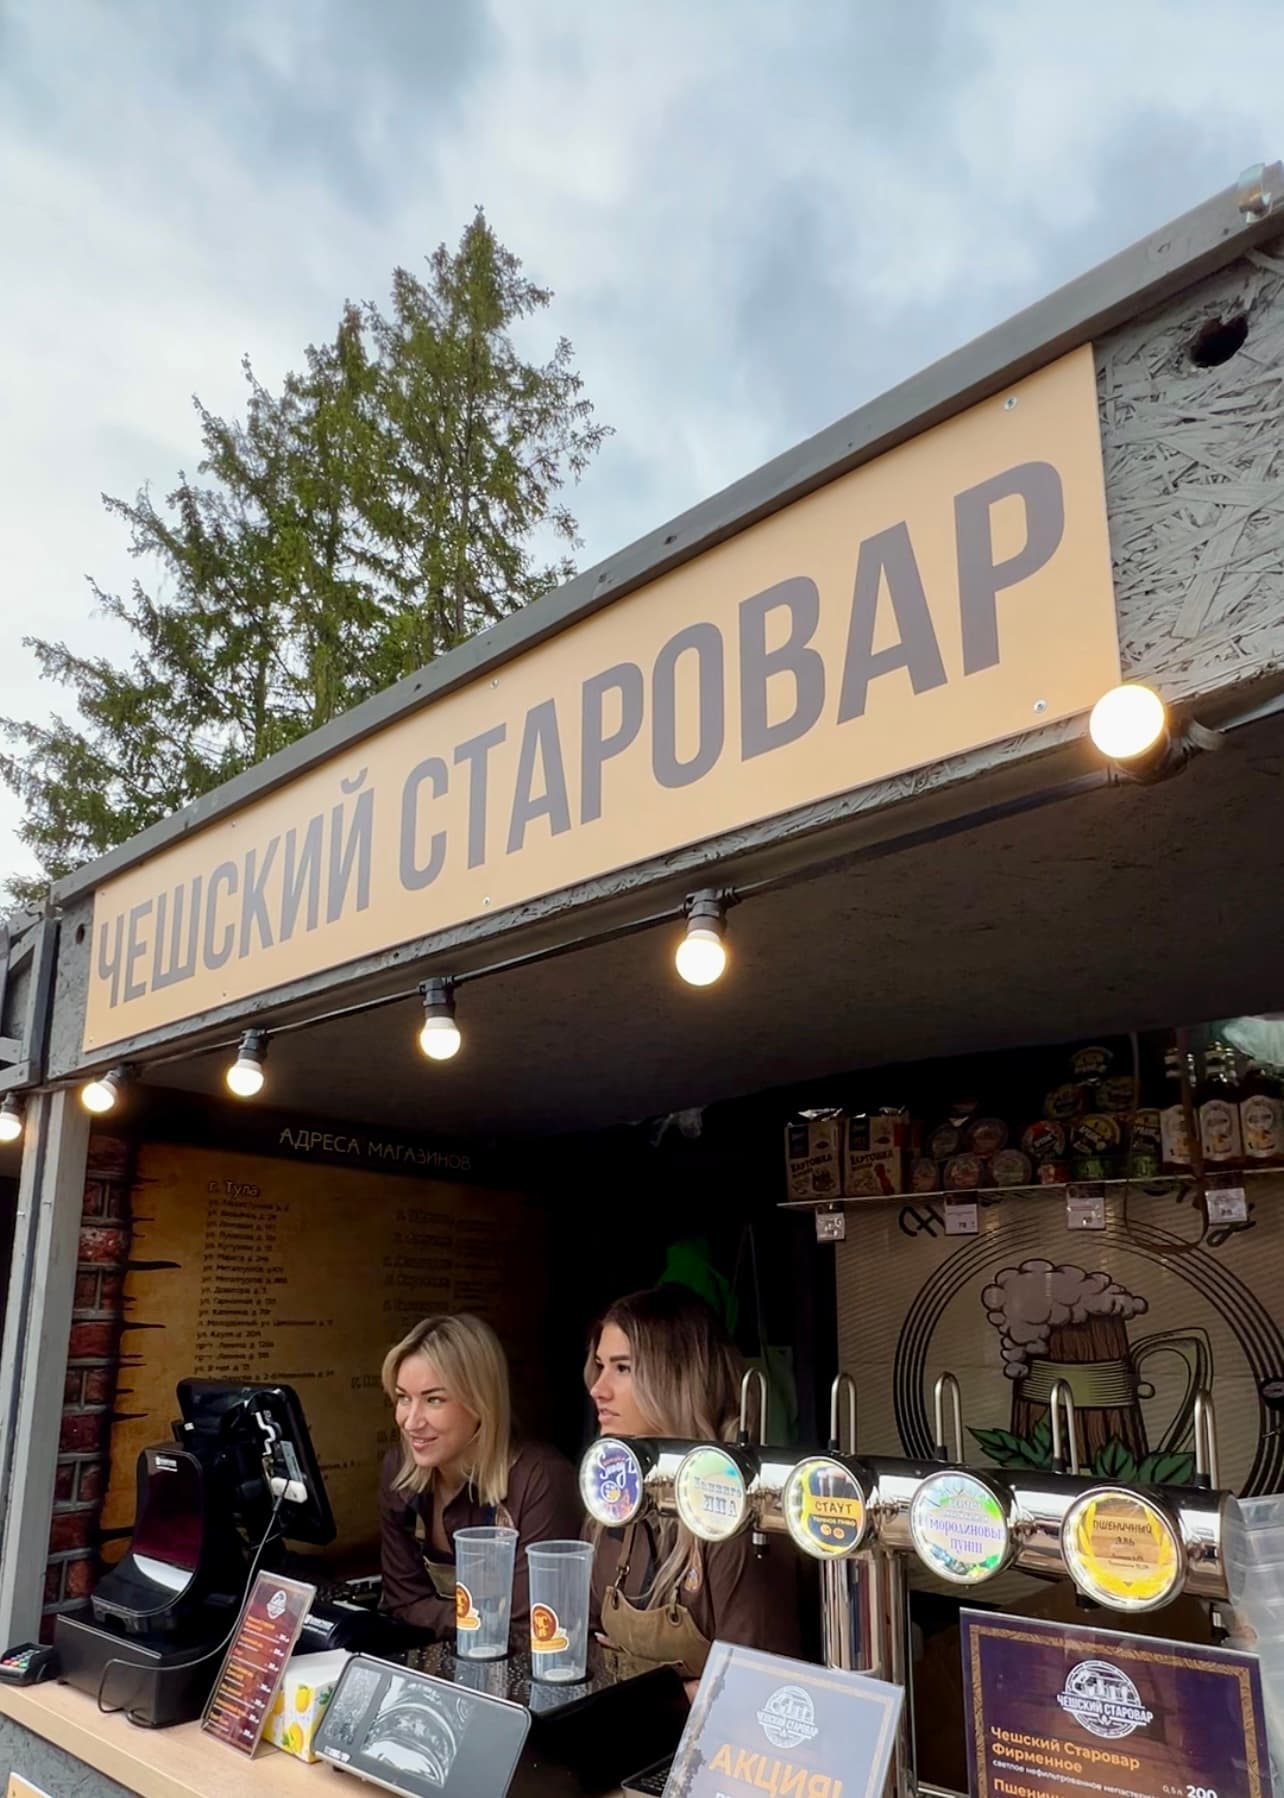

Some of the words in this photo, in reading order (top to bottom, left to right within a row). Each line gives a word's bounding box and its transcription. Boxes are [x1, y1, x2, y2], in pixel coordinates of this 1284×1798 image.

[98, 768, 374, 1008] ЧЕШСКИЙ
[400, 461, 1065, 891] СТАРОВАР
[279, 1127, 361, 1156] АДРЕСА
[367, 1140, 473, 1172] МАГАЗИНОВ
[225, 1181, 260, 1199] Тула
[815, 1500, 854, 1515] СТАУТ
[1057, 1693, 1103, 1714] ЧЕШСКИЙ
[1103, 1703, 1154, 1724] СТАРОВАР
[990, 1726, 1061, 1753] Чешский
[1064, 1742, 1141, 1771] Старовар
[991, 1743, 1083, 1774] Фирменное
[992, 1758, 1025, 1773] светлое
[1025, 1766, 1103, 1792] нефильтрованное
